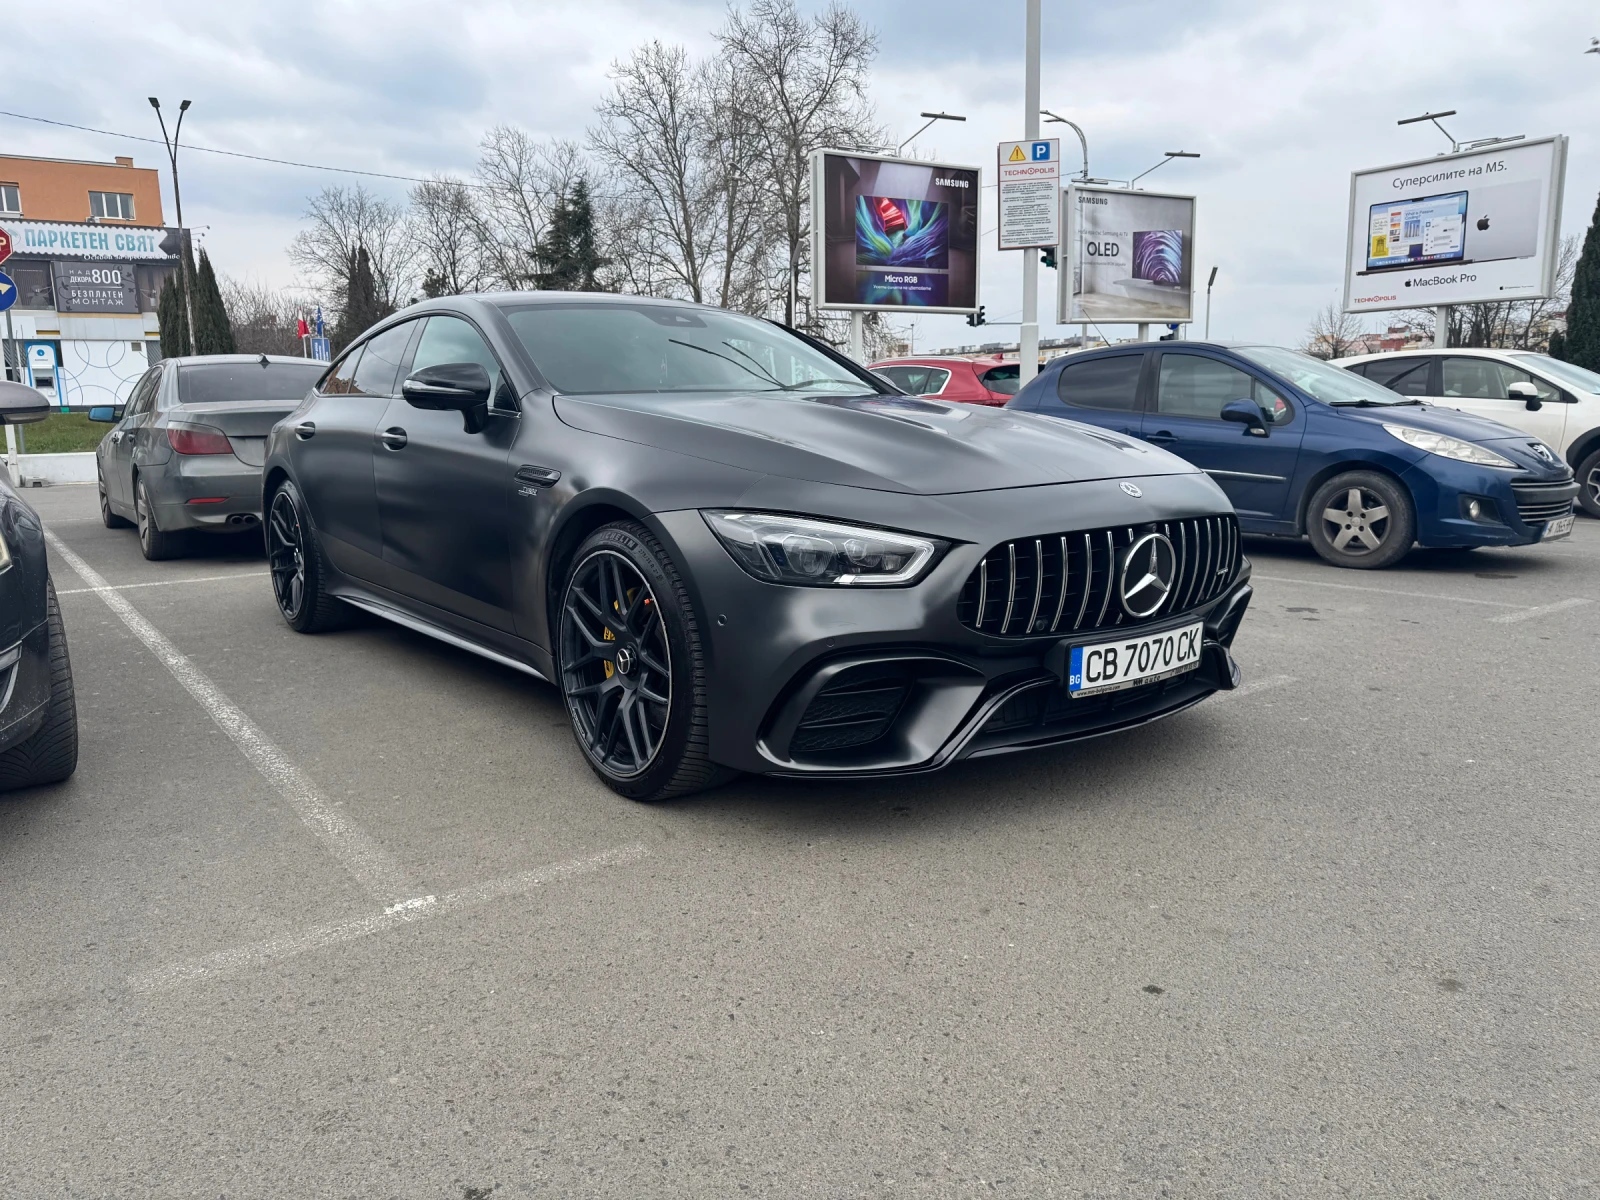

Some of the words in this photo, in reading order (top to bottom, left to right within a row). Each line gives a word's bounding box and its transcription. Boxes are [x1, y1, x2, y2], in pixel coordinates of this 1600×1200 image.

[1036, 145, 1046, 158] P
[1004, 167, 1055, 176] TECHNOPOLIS
[1392, 168, 1466, 190] Суперсилите
[1468, 165, 1482, 176] на
[1485, 161, 1508, 173] M5.
[935, 177, 969, 189] SAMSUNG
[1078, 196, 1108, 205] SAMSUNG
[24, 228, 109, 251] ПАРКЕТЕН
[115, 233, 155, 252] СВЯТ
[1087, 241, 1119, 257] OLED
[69, 275, 92, 283] ДЕКОРА
[91, 268, 122, 285] 800
[884, 274, 903, 283] Micro
[904, 275, 918, 284] RGB
[1413, 276, 1458, 287] MacBook
[1460, 273, 1477, 283] Pro
[71, 290, 124, 298] БЕЗПЛАТЕН
[1354, 295, 1397, 304] TECHNOPOLIS
[72, 298, 124, 306] МОНТАЖ
[1123, 635, 1174, 677] 7070
[1069, 674, 1081, 685] BG
